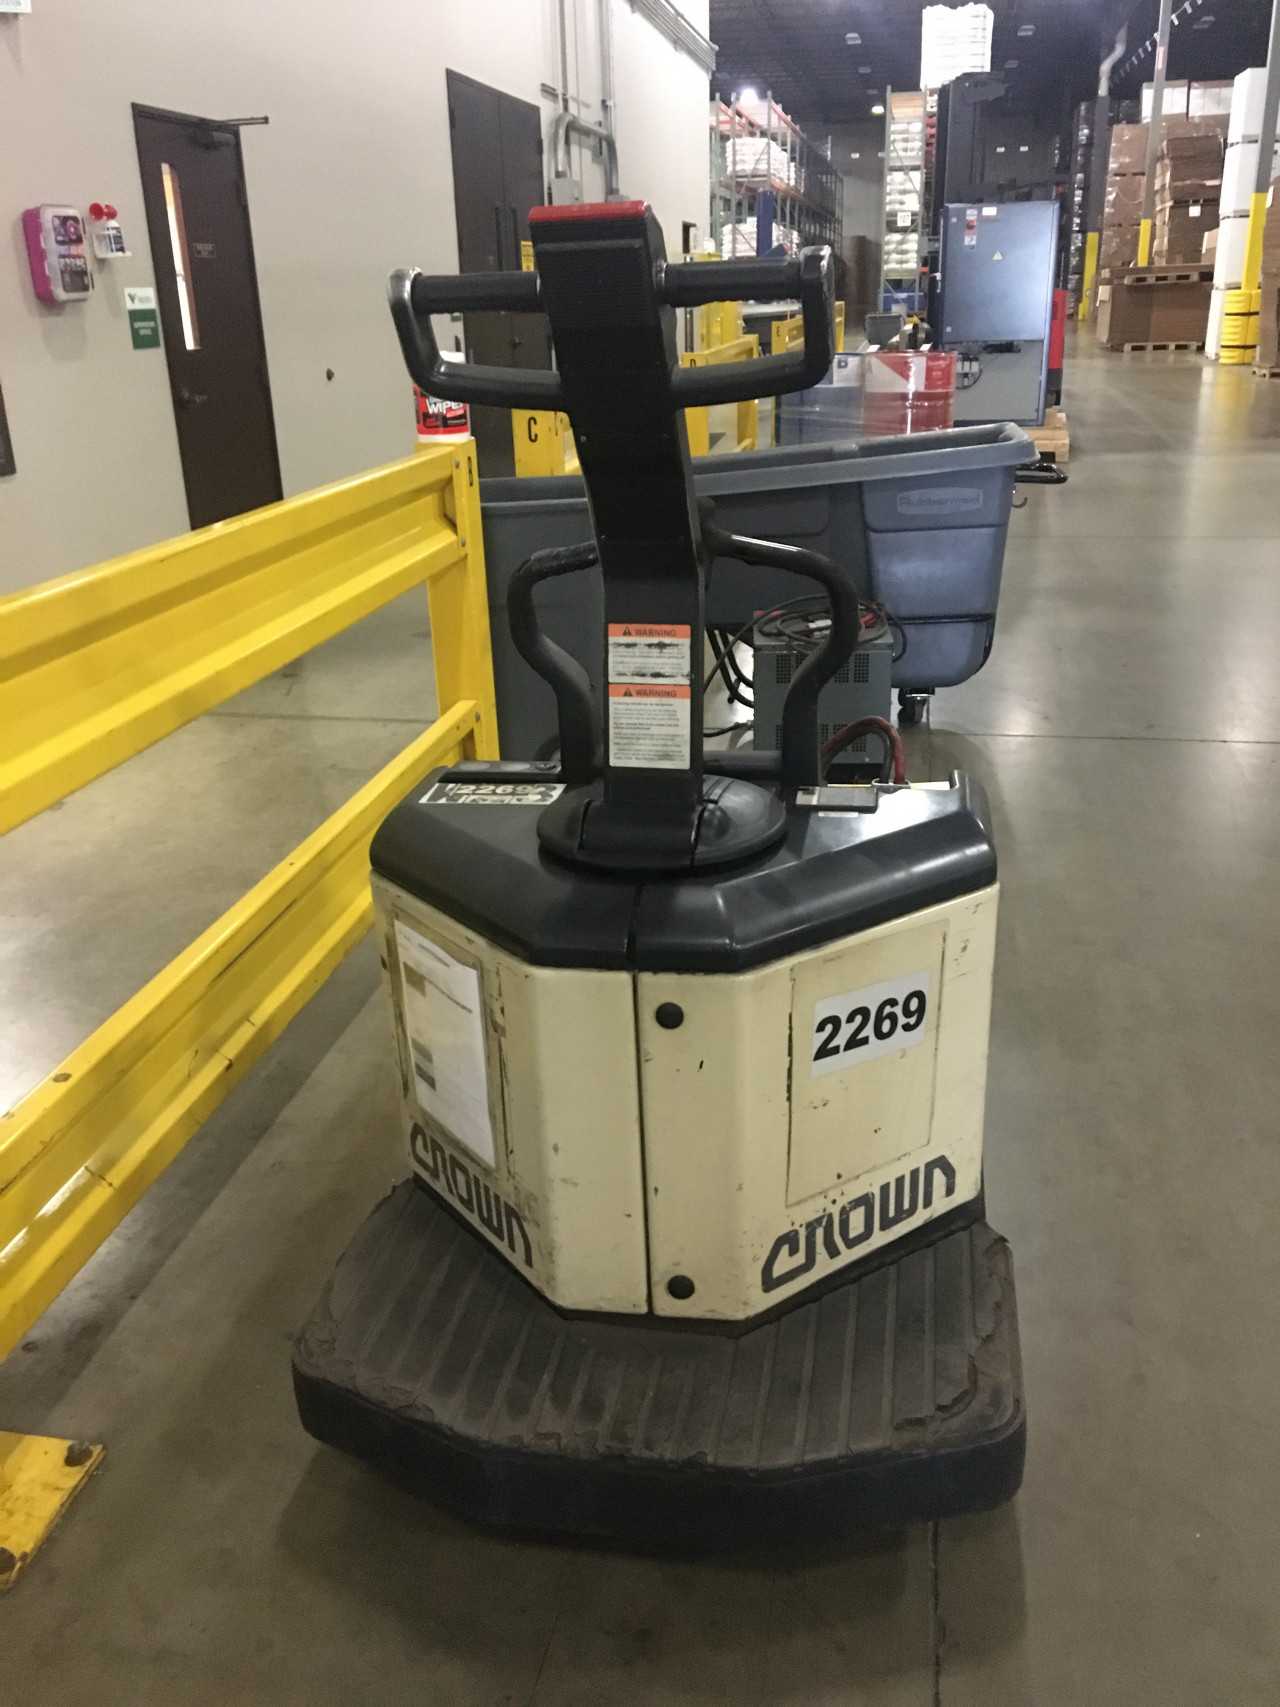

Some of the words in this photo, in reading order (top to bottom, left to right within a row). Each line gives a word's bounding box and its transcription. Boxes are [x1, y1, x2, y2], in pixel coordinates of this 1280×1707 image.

[528, 416, 538, 443] C
[634, 629, 677, 638] WARNING
[635, 689, 678, 698] WARNING
[812, 989, 927, 1062] 2269
